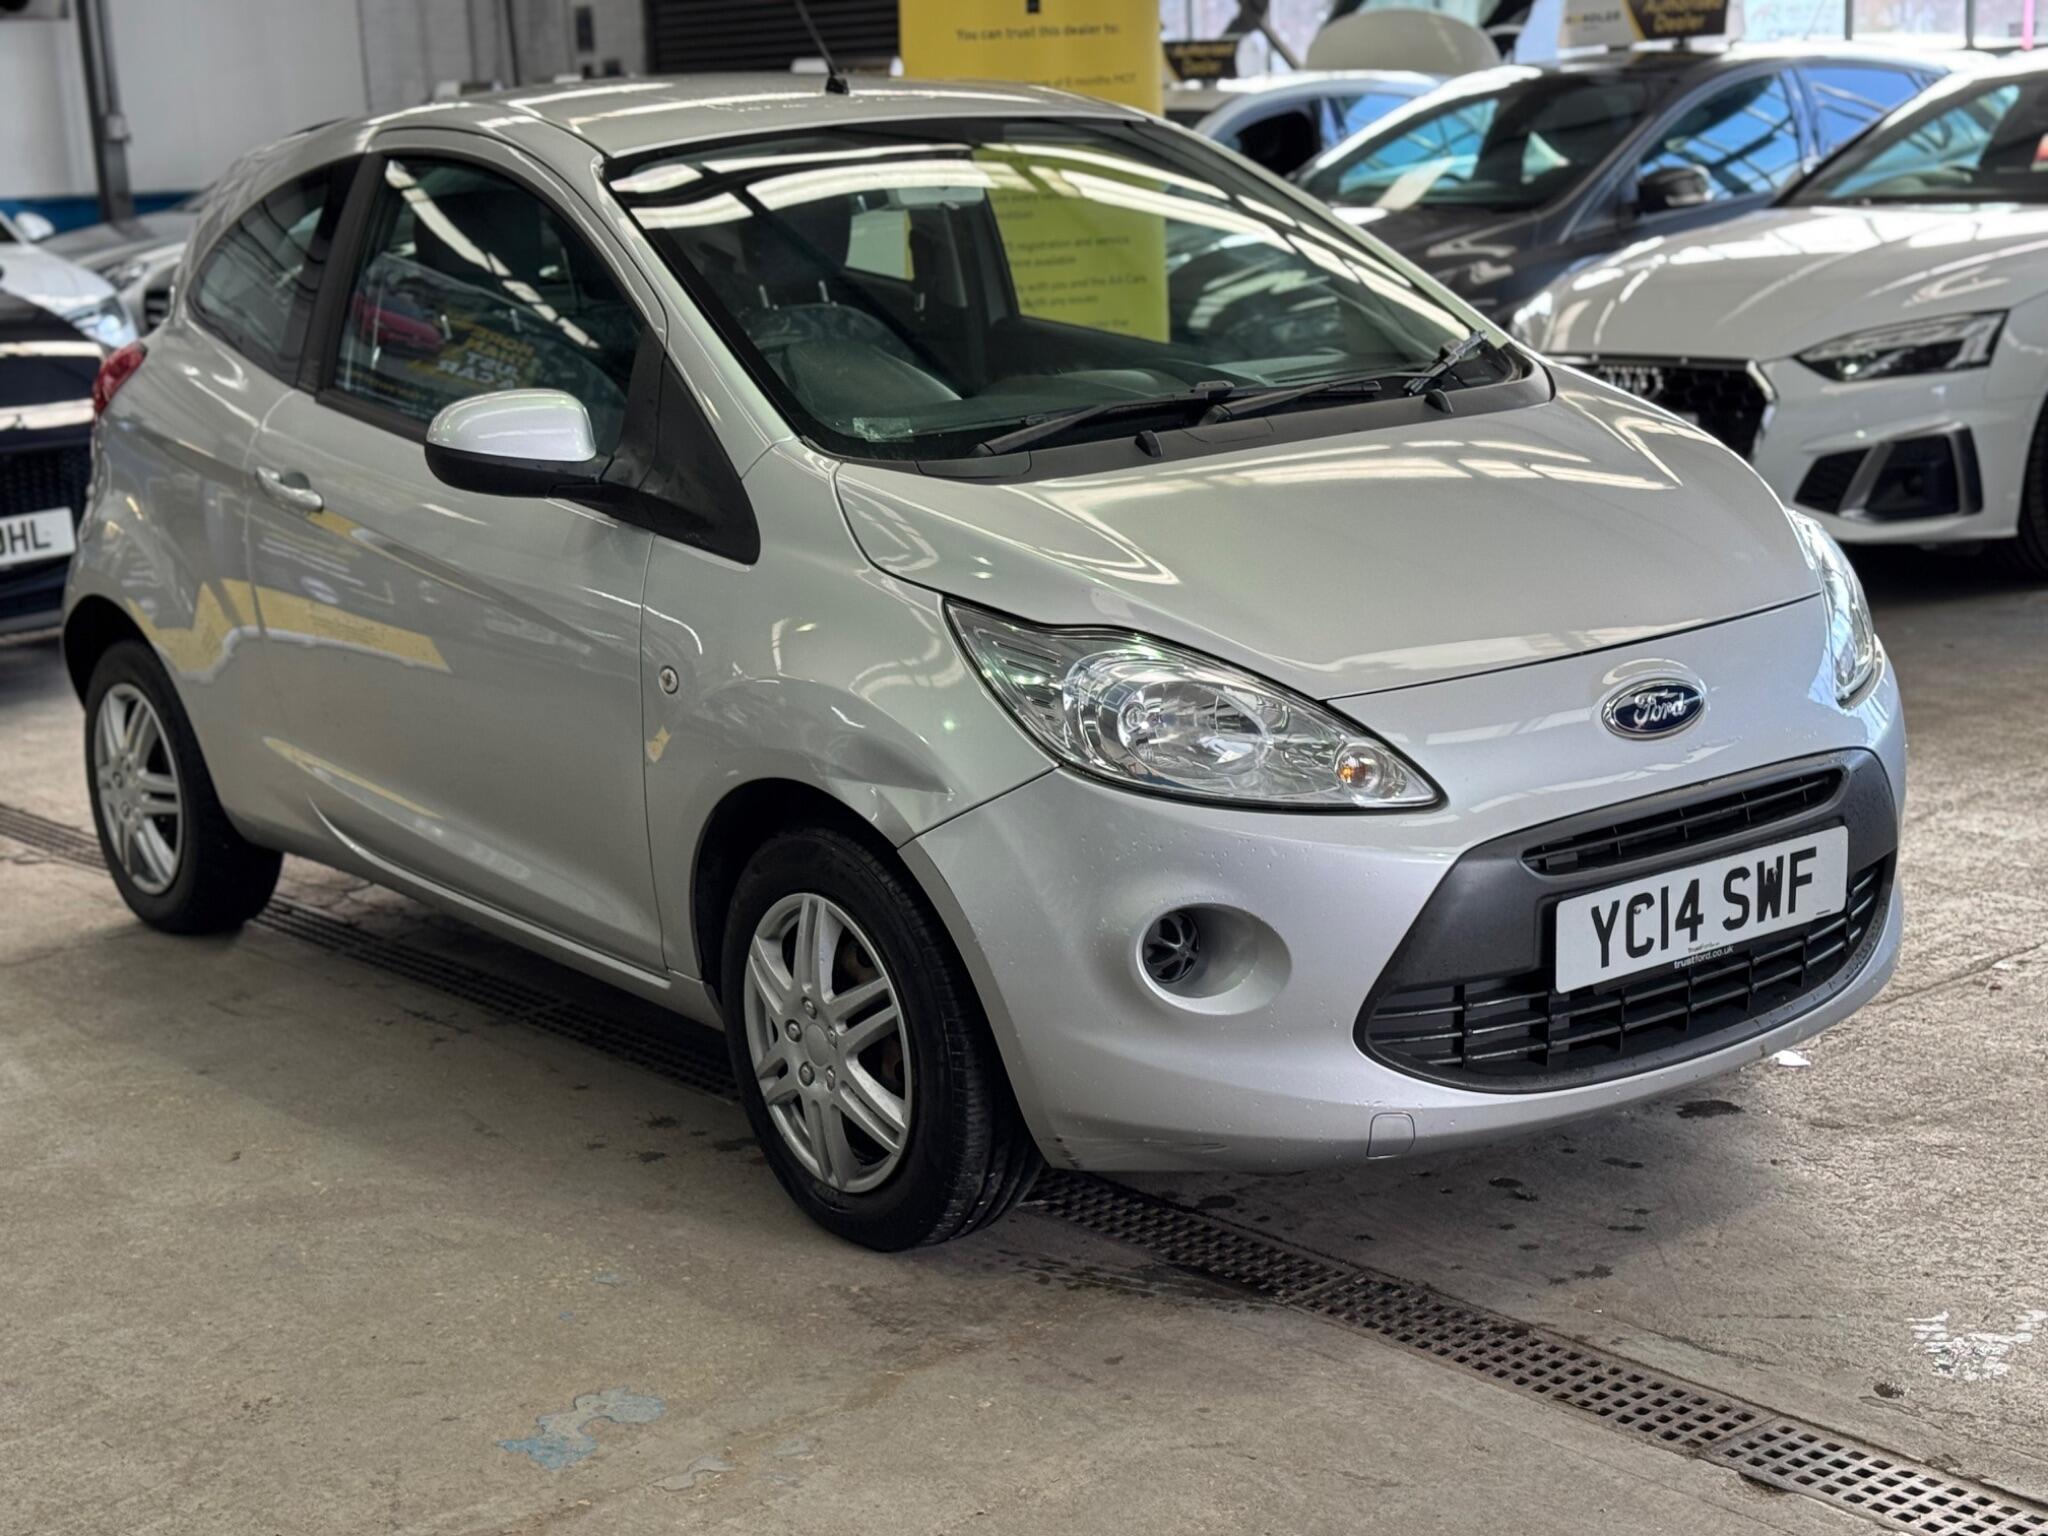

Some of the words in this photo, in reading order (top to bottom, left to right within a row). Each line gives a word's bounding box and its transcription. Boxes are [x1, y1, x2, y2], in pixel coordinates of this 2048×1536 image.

[956, 28, 978, 41] You
[981, 29, 1001, 40] can
[1006, 26, 1035, 39] trust
[1039, 25, 1060, 37] this
[1064, 23, 1101, 36] dealer
[1075, 75, 1111, 86] months
[1633, 688, 1687, 729] Ford
[1590, 878, 1704, 969] YC14
[1722, 847, 1818, 932] SWF
[1673, 945, 1735, 969] trustford.co.uk
